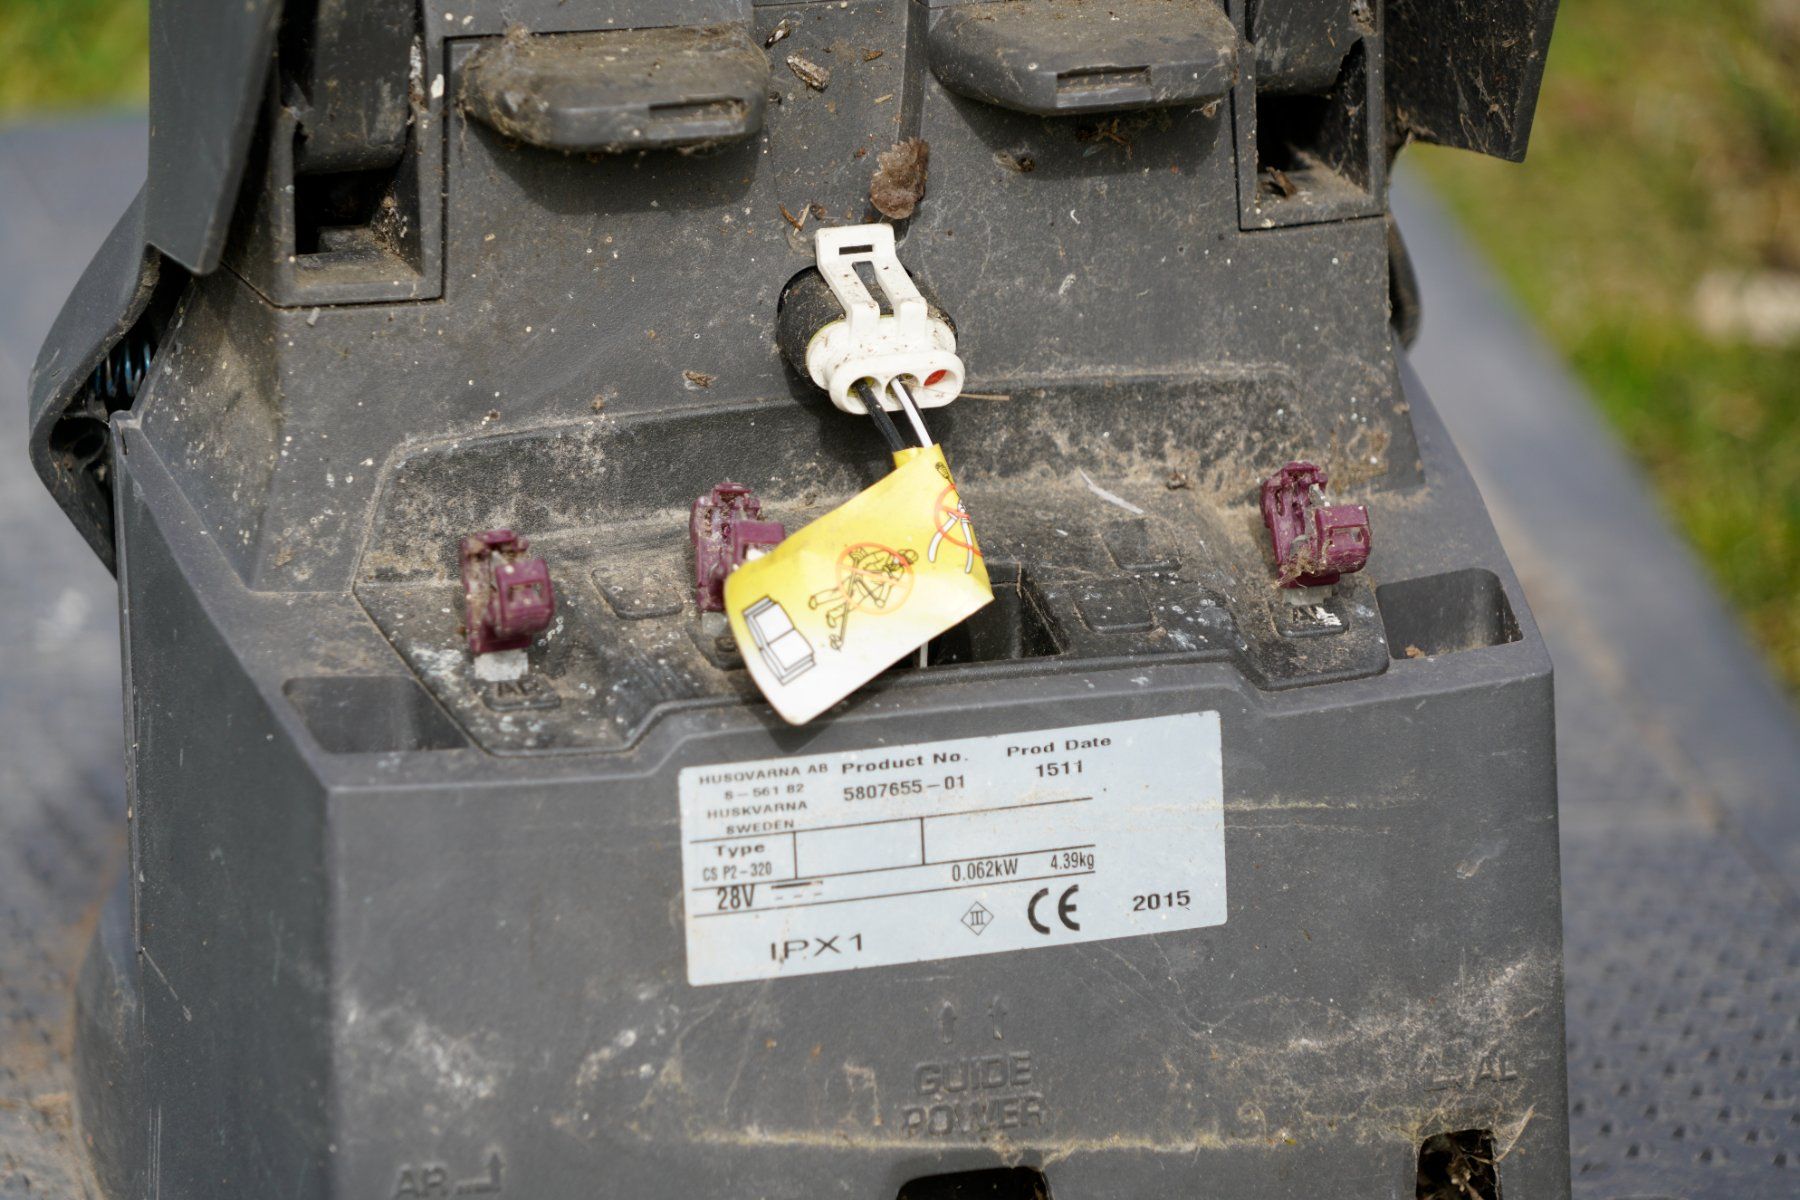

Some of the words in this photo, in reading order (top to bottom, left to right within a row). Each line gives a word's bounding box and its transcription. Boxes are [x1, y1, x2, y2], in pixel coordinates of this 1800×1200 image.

[1006, 742, 1055, 757] Prod
[1065, 736, 1112, 751] Date
[841, 755, 924, 774] Product
[933, 751, 968, 764] No.
[1035, 760, 1083, 778] 1511
[698, 766, 801, 785] HUSQVARNA
[807, 763, 828, 775] AB
[787, 783, 805, 794] 82
[706, 800, 808, 819] HUSKVARNA
[726, 820, 795, 835] SWEDEN
[715, 842, 765, 859] Type
[1050, 852, 1095, 871] 4.39kg
[702, 866, 718, 882] CS
[951, 859, 1018, 882] 0.062kW
[717, 884, 756, 910] 28V
[1132, 890, 1191, 912] 2015
[1027, 884, 1080, 935] CE
[770, 932, 862, 960] IPX1
[914, 1051, 1032, 1096] GUIDE
[389, 1161, 449, 1199] AR
